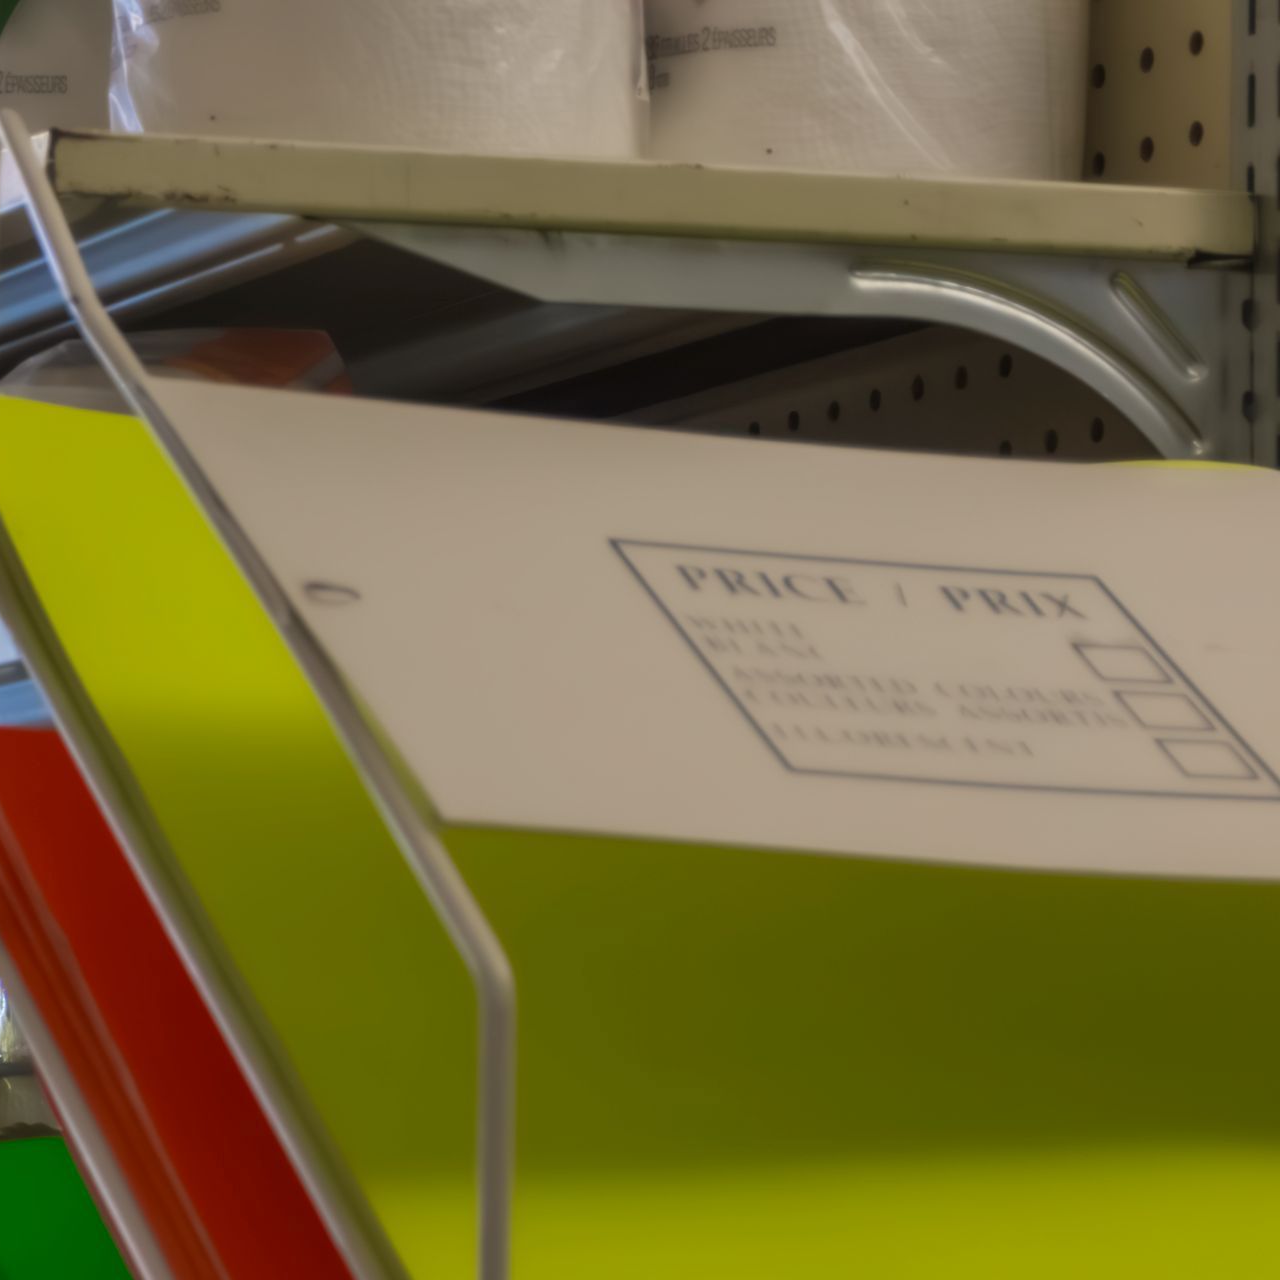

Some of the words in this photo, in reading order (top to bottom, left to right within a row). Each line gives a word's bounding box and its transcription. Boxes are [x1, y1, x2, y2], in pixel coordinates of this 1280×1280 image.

[701, 26, 711, 51] 2
[5, 71, 68, 95] ÉPAISSEURS
[676, 563, 866, 607] PRICE
[892, 580, 909, 608] /
[938, 584, 1088, 621] PRIX
